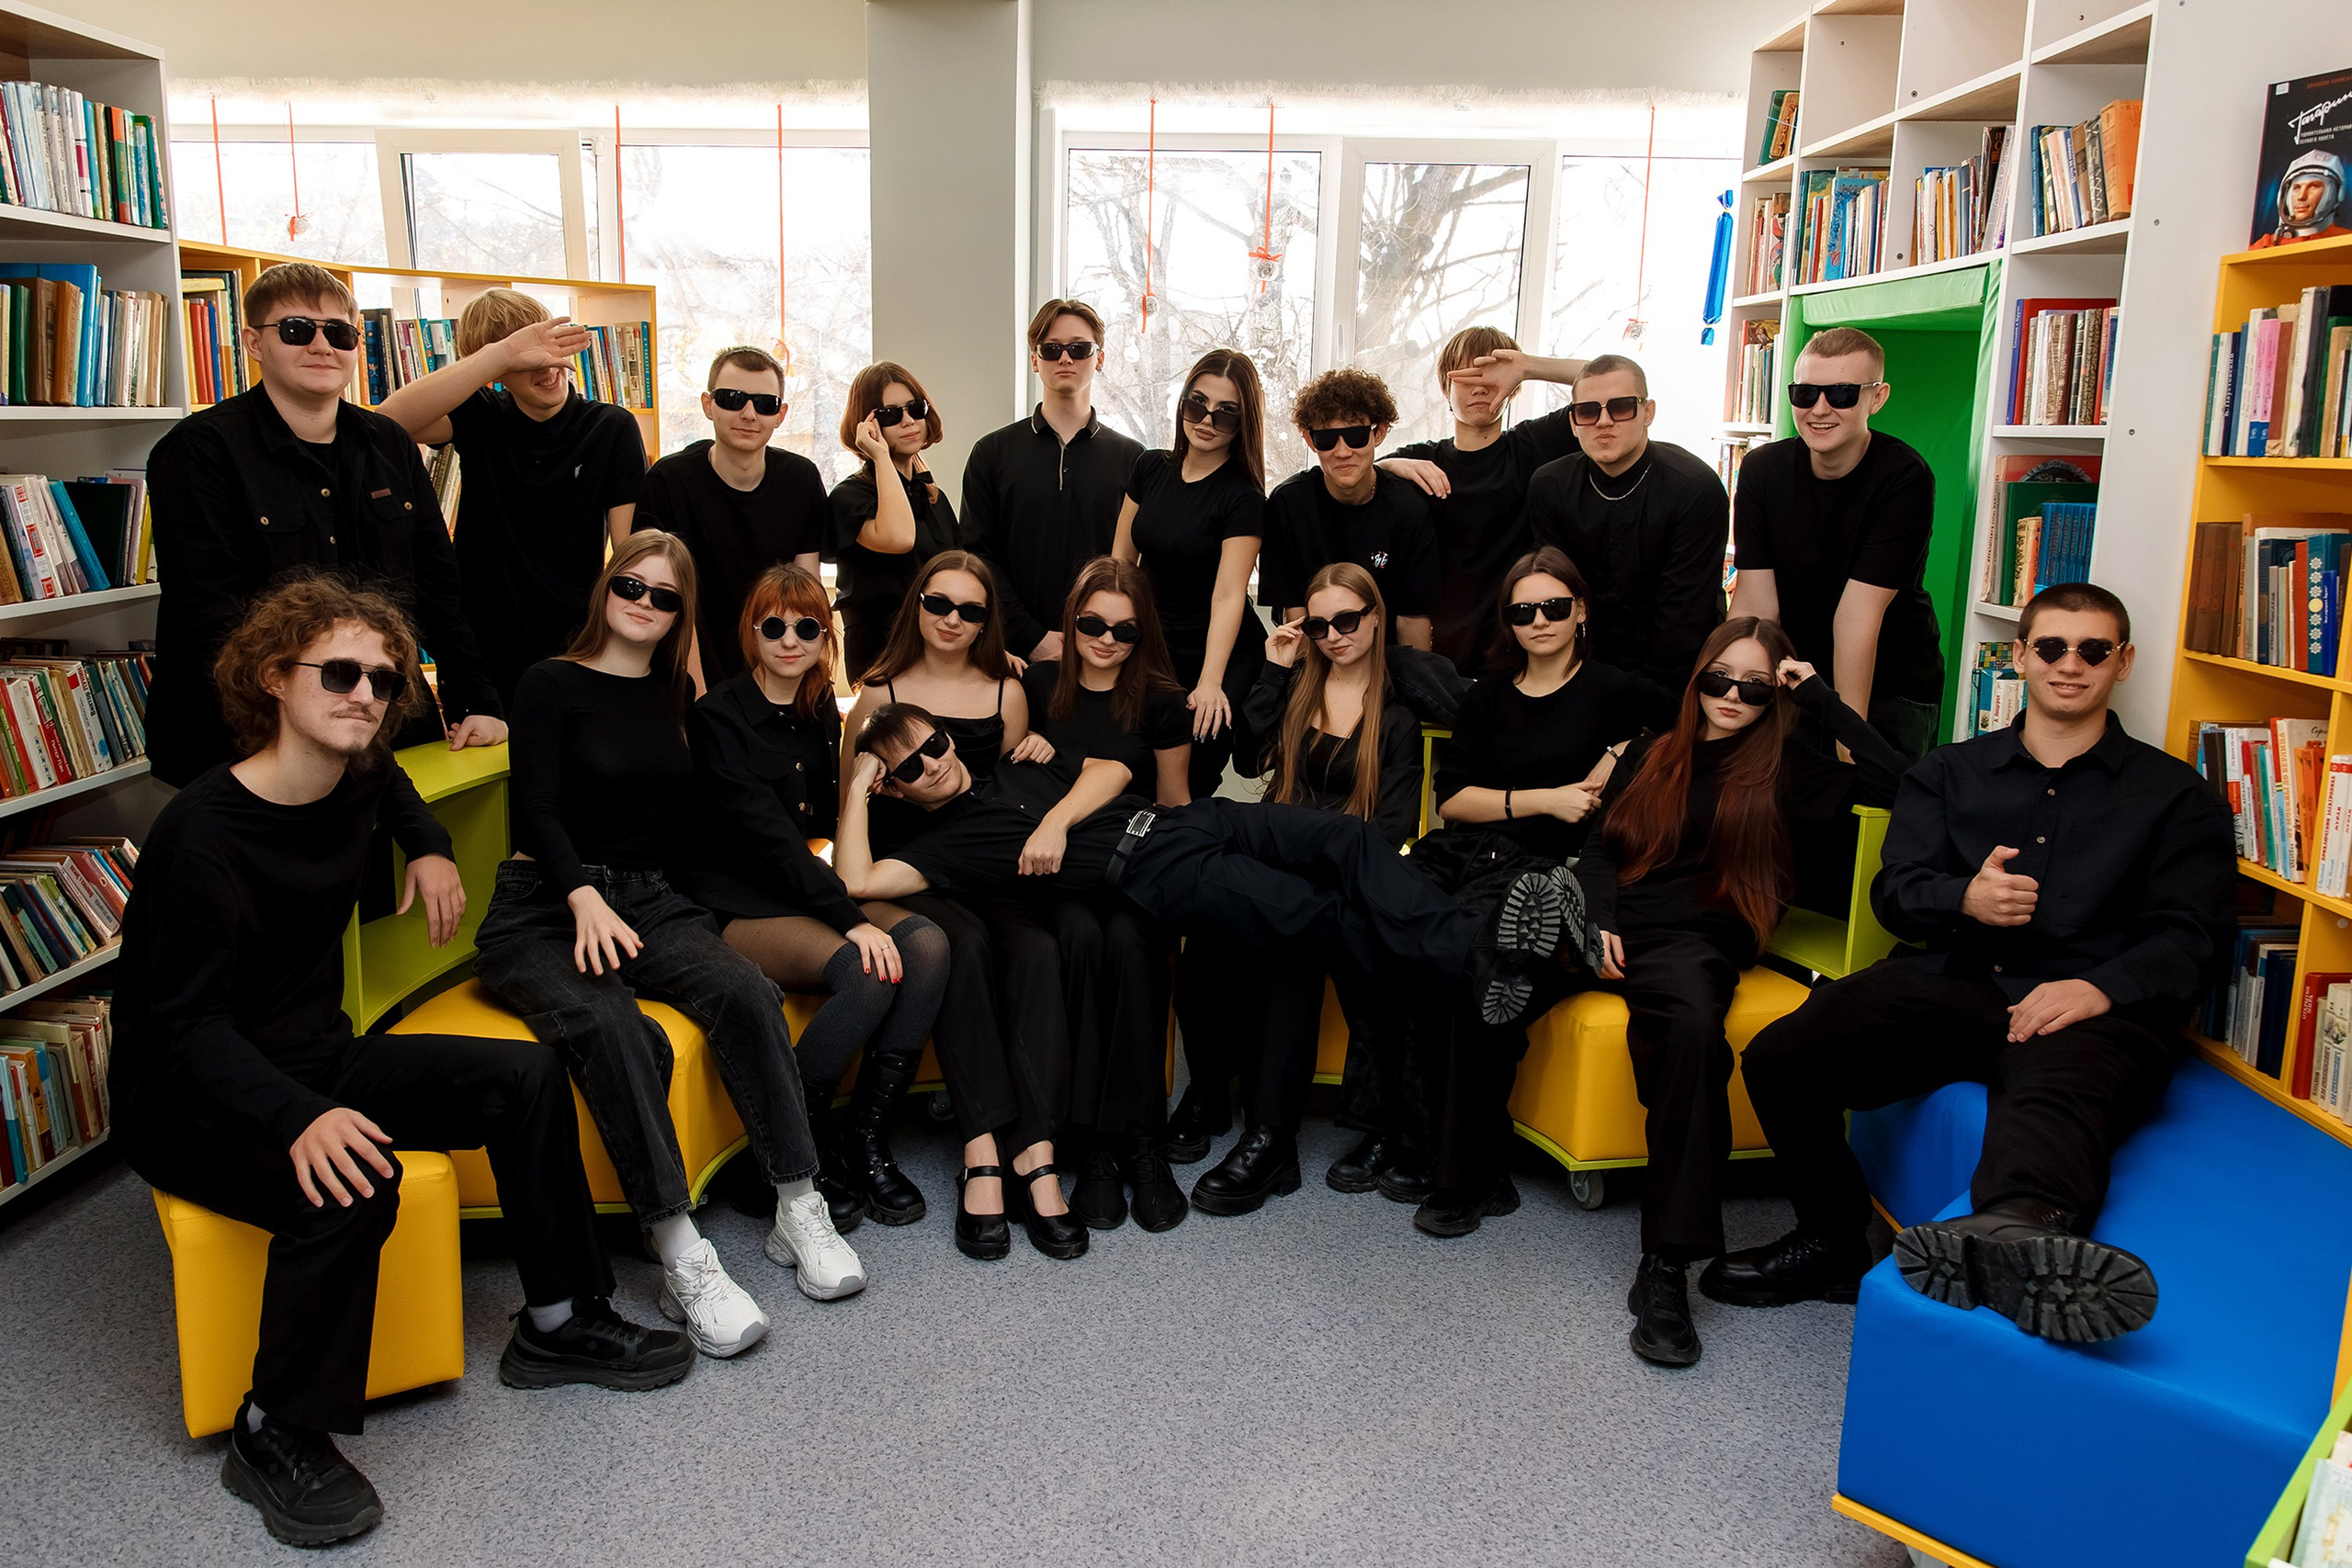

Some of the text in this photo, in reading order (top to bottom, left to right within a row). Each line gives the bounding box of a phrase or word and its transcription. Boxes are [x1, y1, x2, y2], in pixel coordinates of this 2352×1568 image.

[77, 667, 88, 692] ЛУНИН
[85, 692, 96, 716] Виктор
[2278, 732, 2288, 773] БЕРЛИНА
